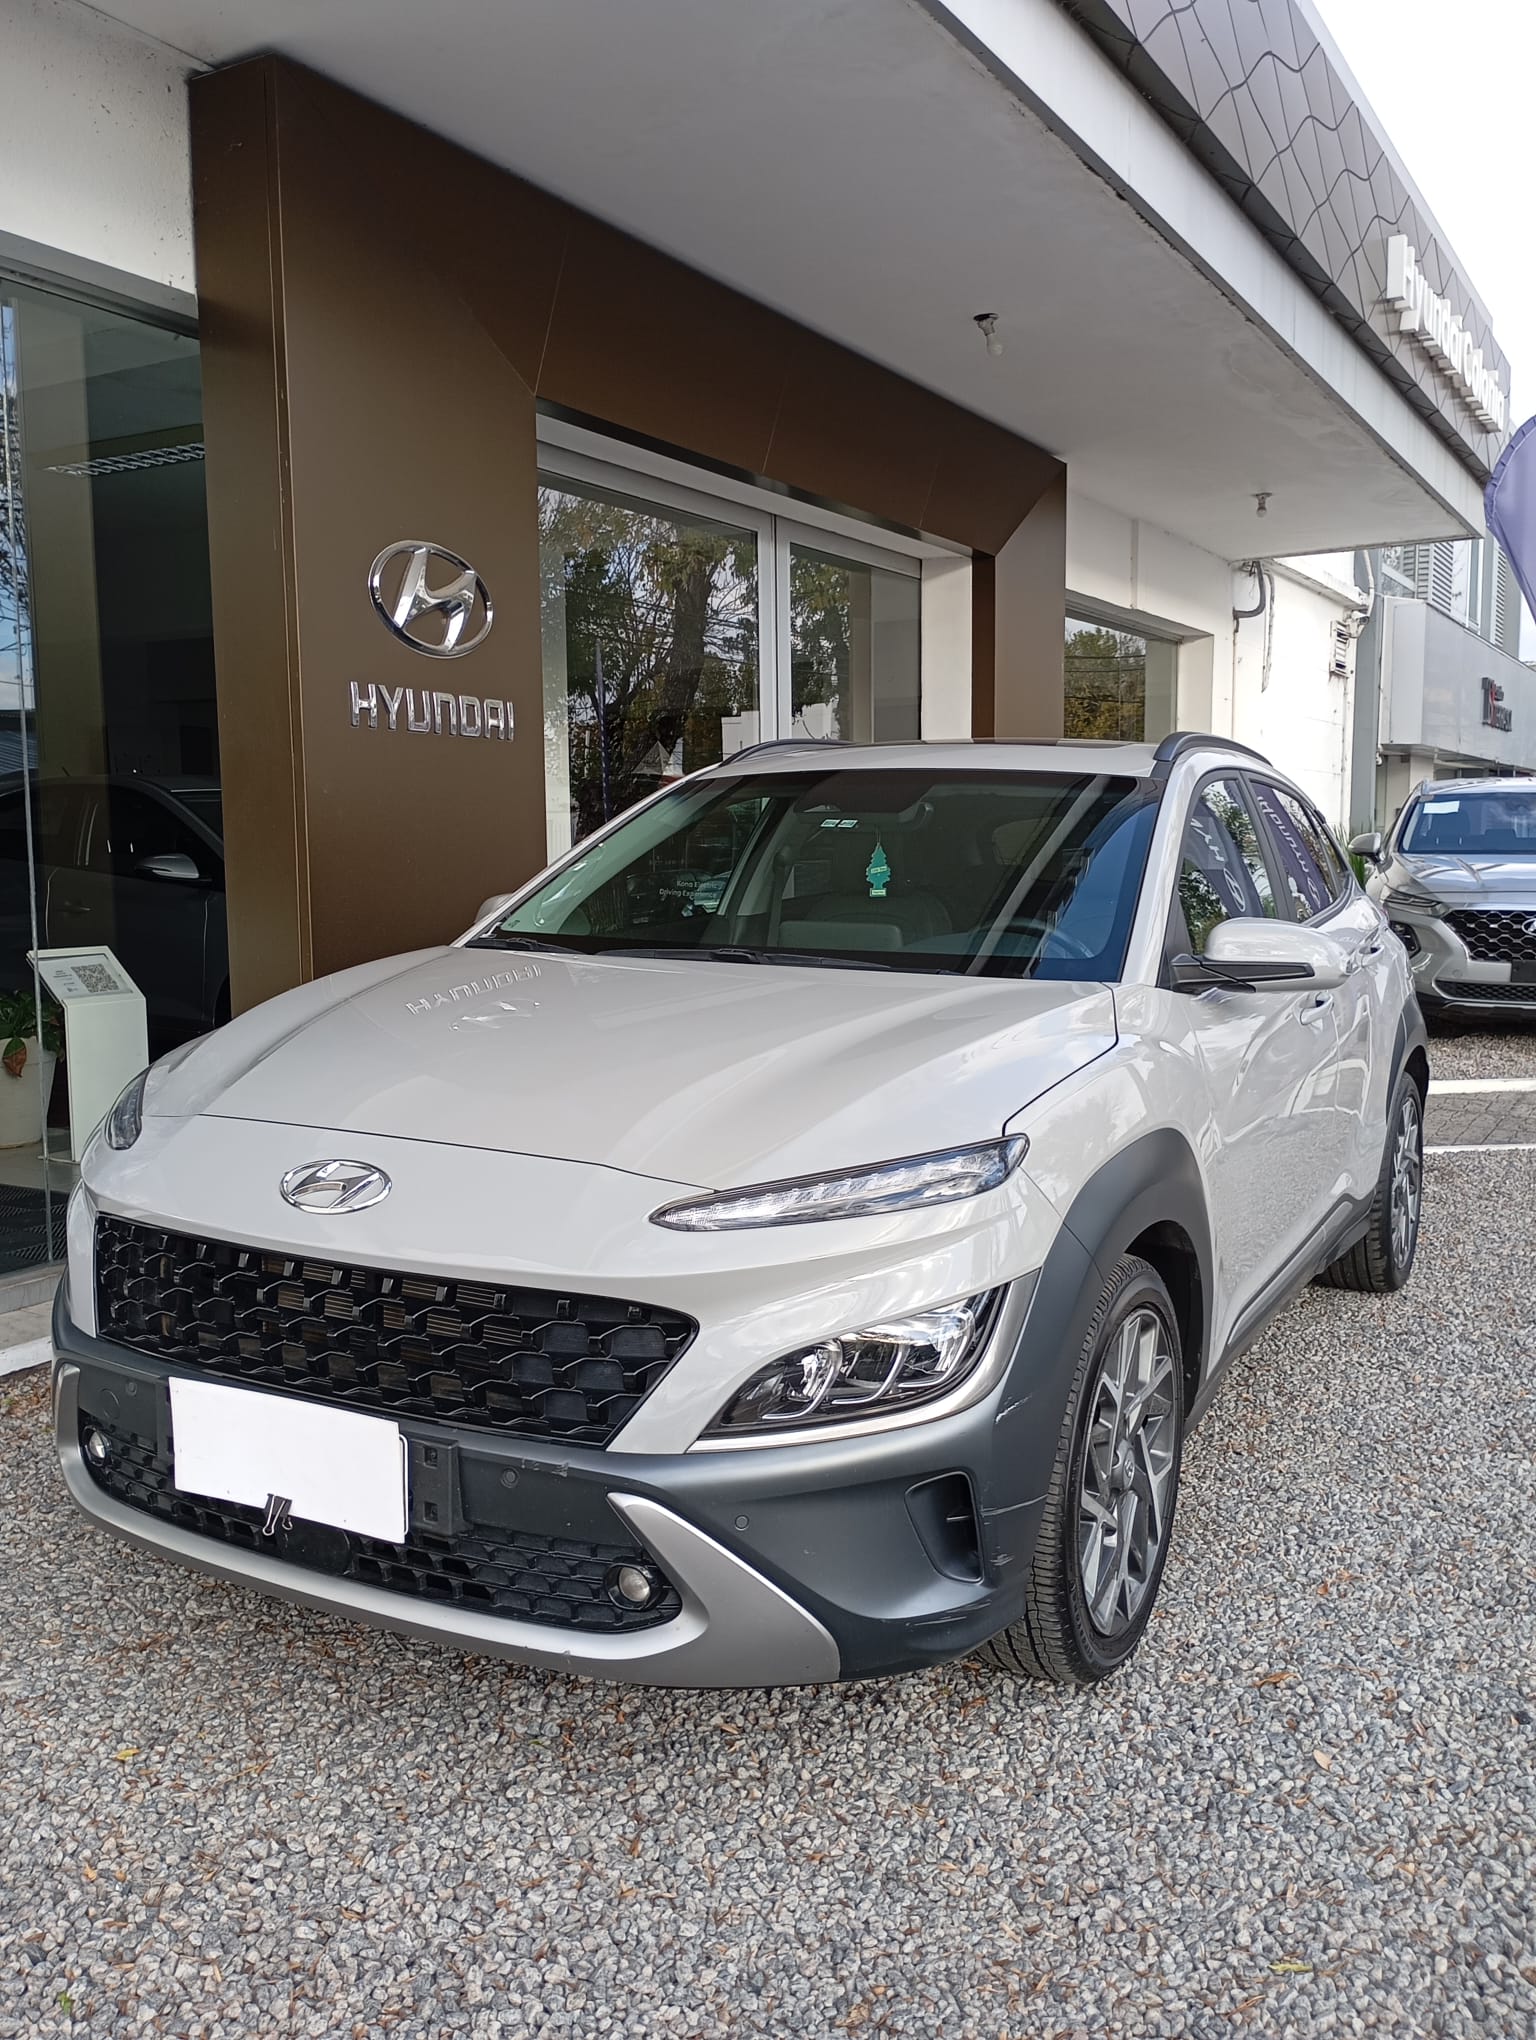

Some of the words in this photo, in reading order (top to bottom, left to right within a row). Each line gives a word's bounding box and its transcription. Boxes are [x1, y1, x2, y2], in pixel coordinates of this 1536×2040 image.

[1387, 234, 1463, 374] Hyundai
[350, 681, 514, 741] HYUNDAI
[677, 880, 693, 888] Kona
